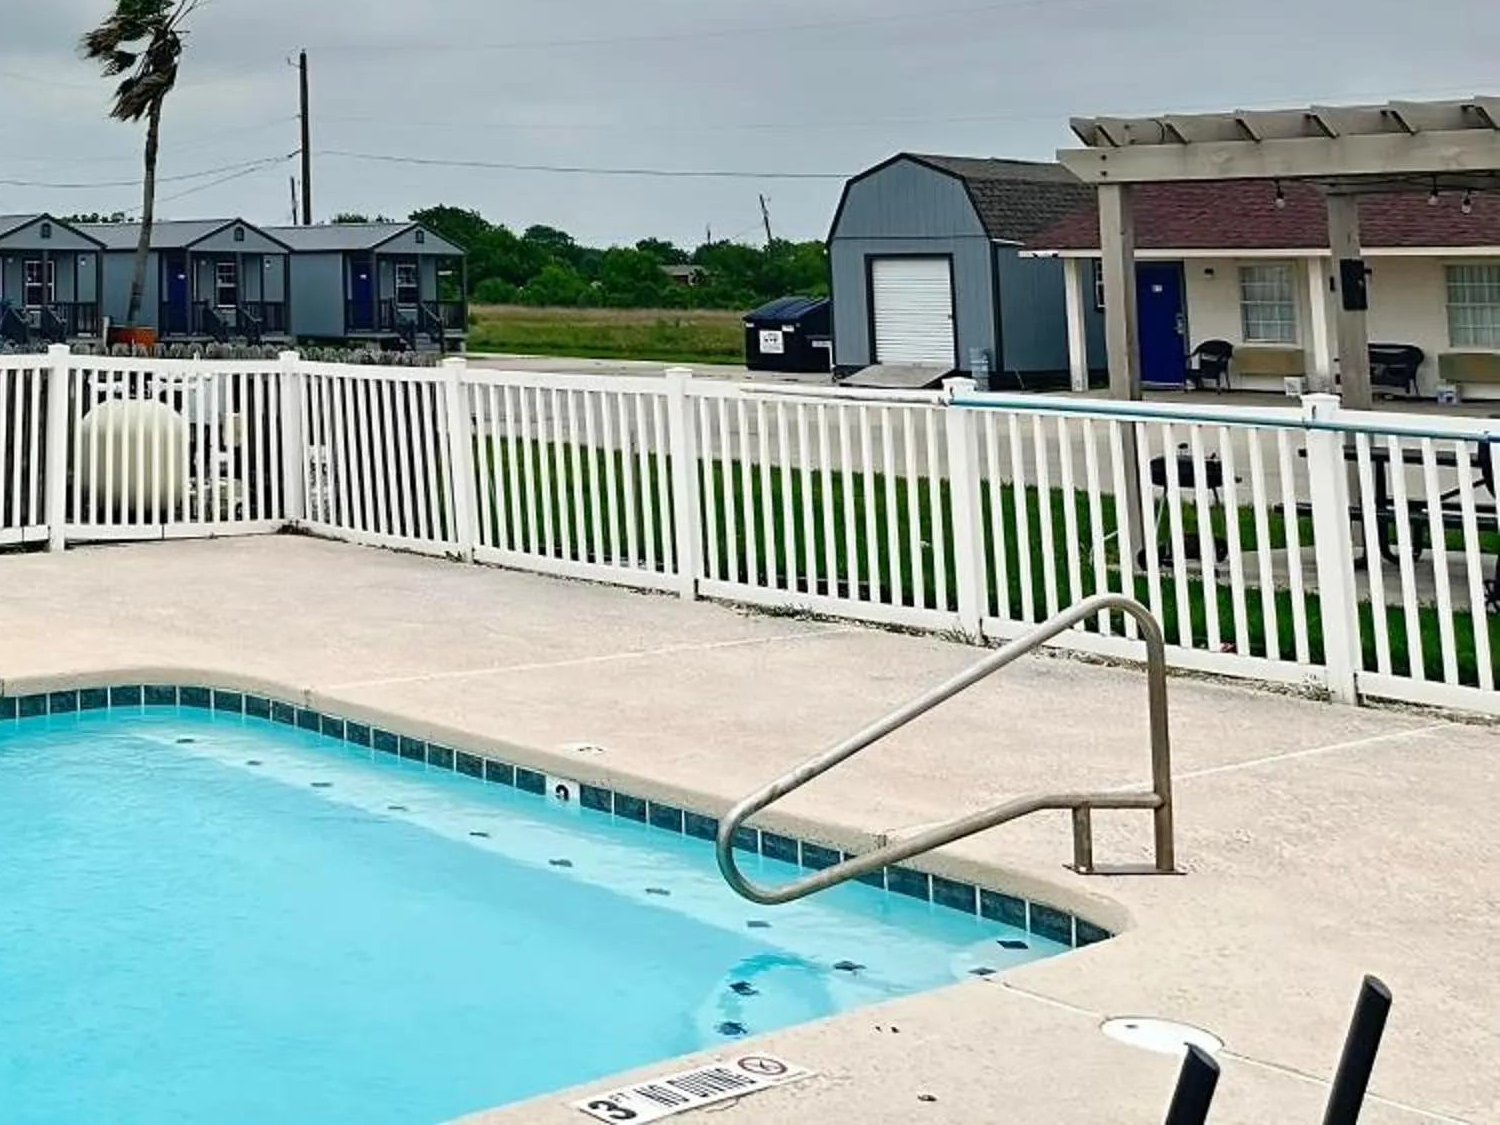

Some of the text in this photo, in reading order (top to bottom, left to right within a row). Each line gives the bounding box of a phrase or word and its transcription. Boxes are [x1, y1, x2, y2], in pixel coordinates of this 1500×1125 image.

[633, 1068, 757, 1108] NO DIVING
[588, 1100, 637, 1120] 3
